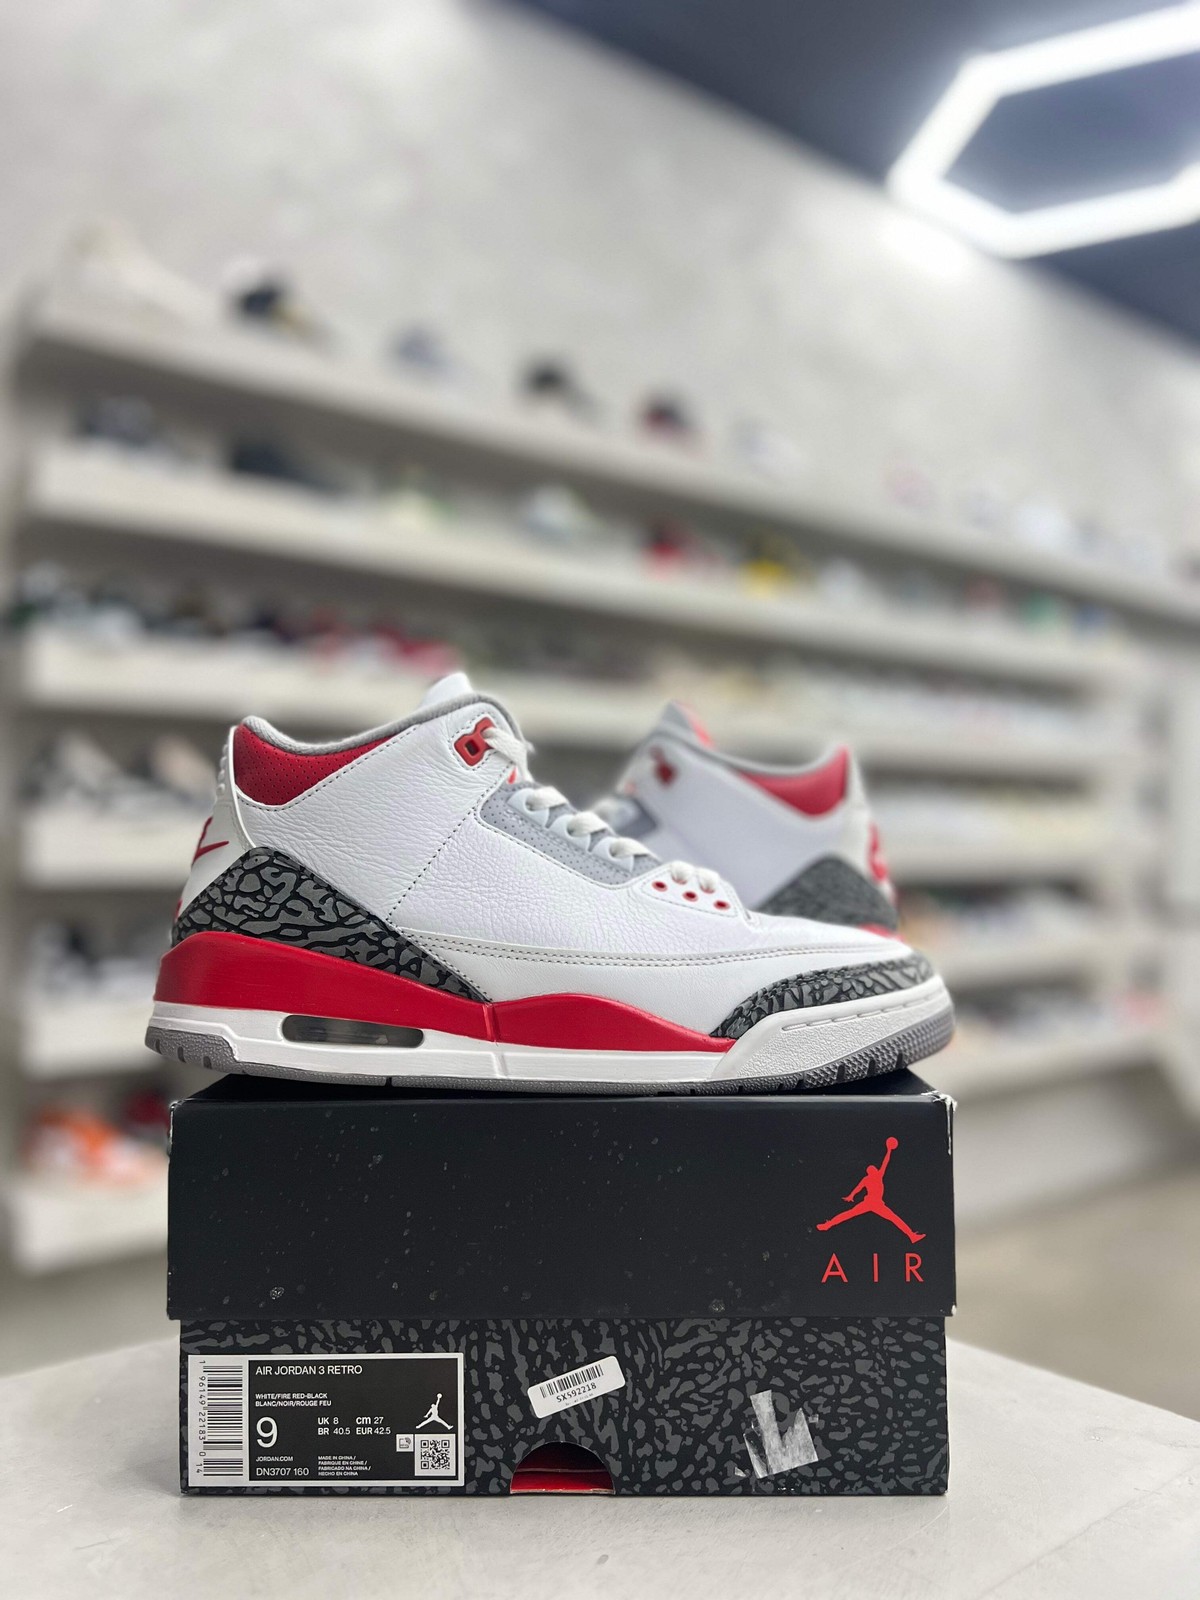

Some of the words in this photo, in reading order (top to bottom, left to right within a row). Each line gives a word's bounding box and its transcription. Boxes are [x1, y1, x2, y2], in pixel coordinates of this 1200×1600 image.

[821, 1253, 924, 1283] AIR
[255, 1366, 272, 1375] AIR
[274, 1365, 316, 1375] JORDAN
[318, 1365, 325, 1374] 3
[327, 1365, 363, 1374] RETRO
[556, 1382, 597, 1403] SX592218
[317, 1417, 330, 1425] UK
[373, 1416, 384, 1424] 27
[256, 1416, 278, 1448] 9
[317, 1427, 330, 1435] BR
[333, 1427, 351, 1435] 40.5
[355, 1427, 373, 1435] EUR
[256, 1467, 292, 1476] DN3707
[293, 1467, 309, 1476] 160
